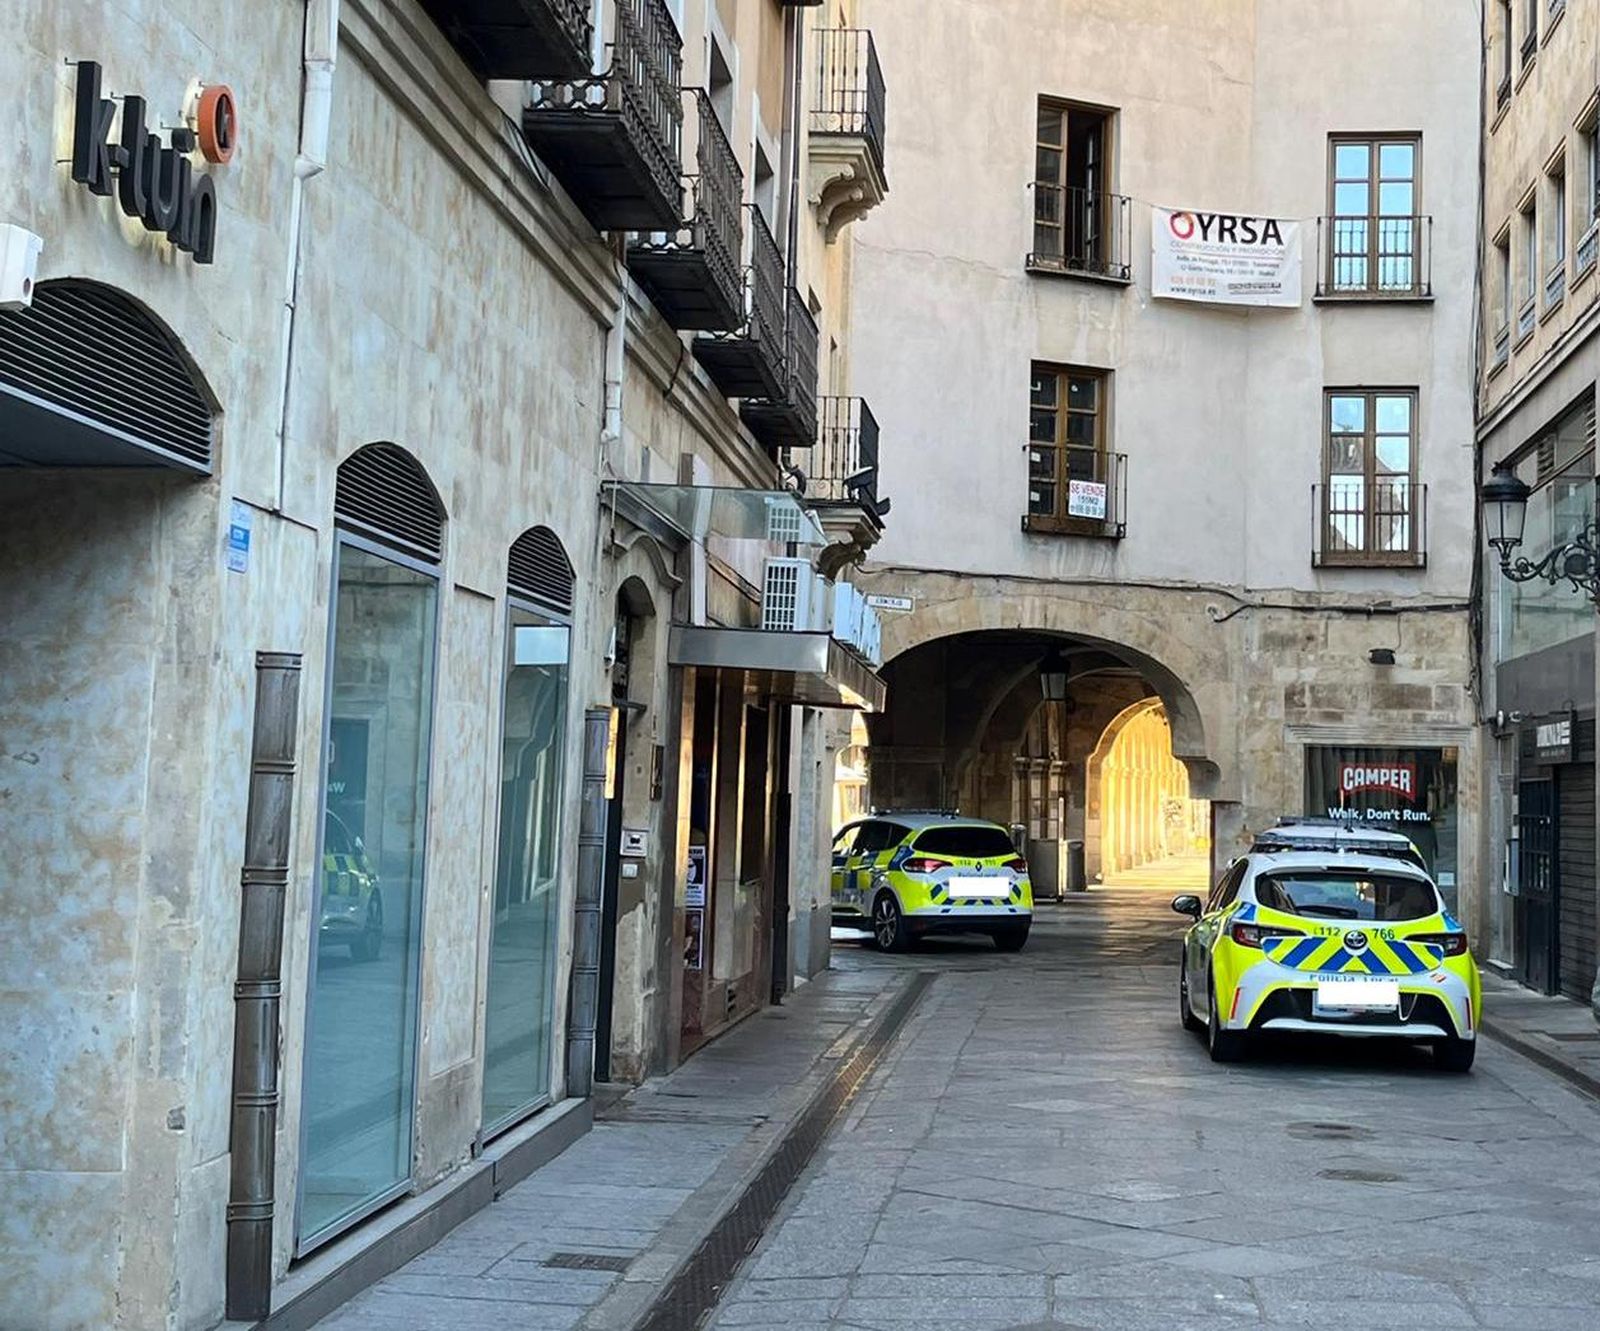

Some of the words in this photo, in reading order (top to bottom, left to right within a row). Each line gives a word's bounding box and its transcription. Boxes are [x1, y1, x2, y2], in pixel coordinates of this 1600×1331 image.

[1169, 211, 1284, 246] OYRSA
[1081, 485, 1105, 497] VENDE
[1343, 767, 1411, 793] CAMPER
[1403, 809, 1431, 821] Run.
[1319, 927, 1341, 937] 112
[1371, 928, 1395, 940] 766
